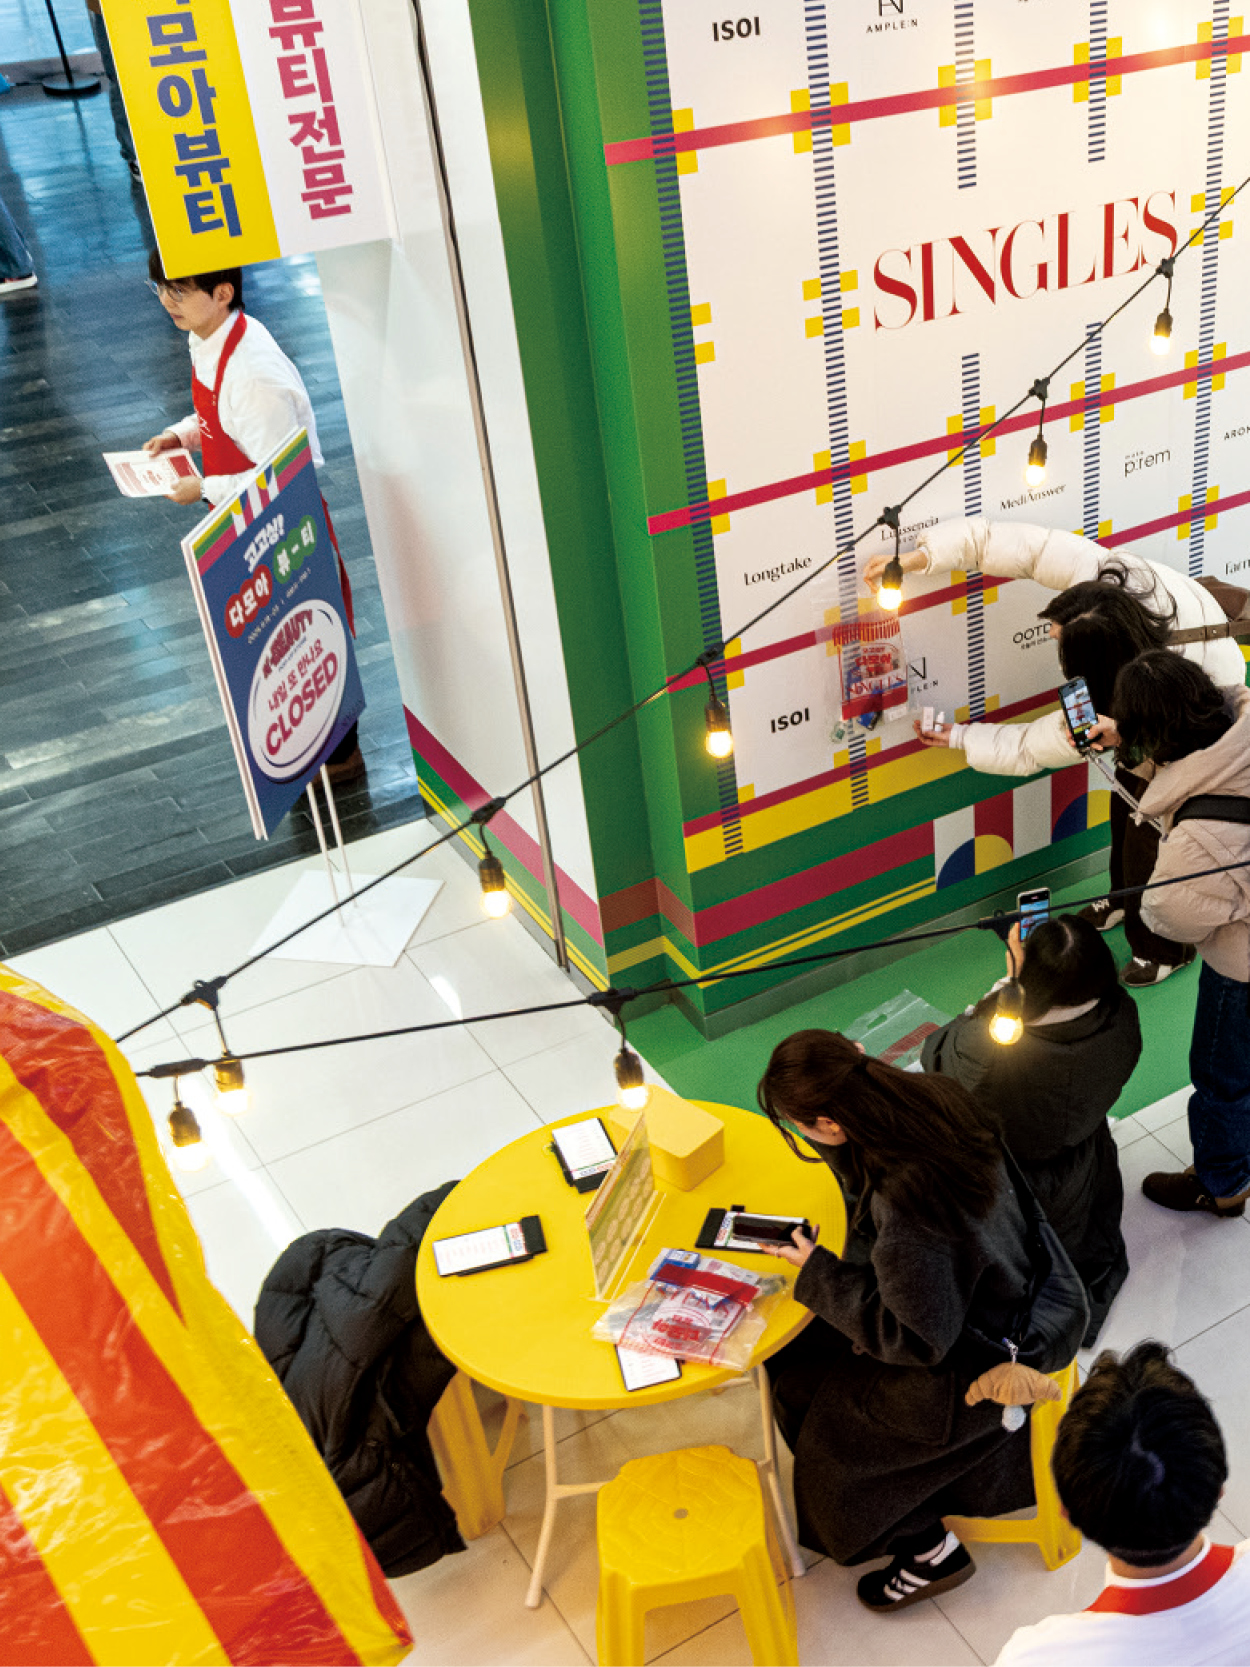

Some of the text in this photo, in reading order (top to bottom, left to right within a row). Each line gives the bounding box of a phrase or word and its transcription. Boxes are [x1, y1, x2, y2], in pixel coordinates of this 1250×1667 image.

[712, 16, 761, 42] ISOI
[146, 0, 242, 237] 모아뷰티
[873, 190, 1178, 332] SINGLES
[228, 571, 270, 628] 다모아
[743, 555, 813, 587] Longtake
[265, 651, 338, 756] CLOSED
[770, 707, 810, 734] ISOI
